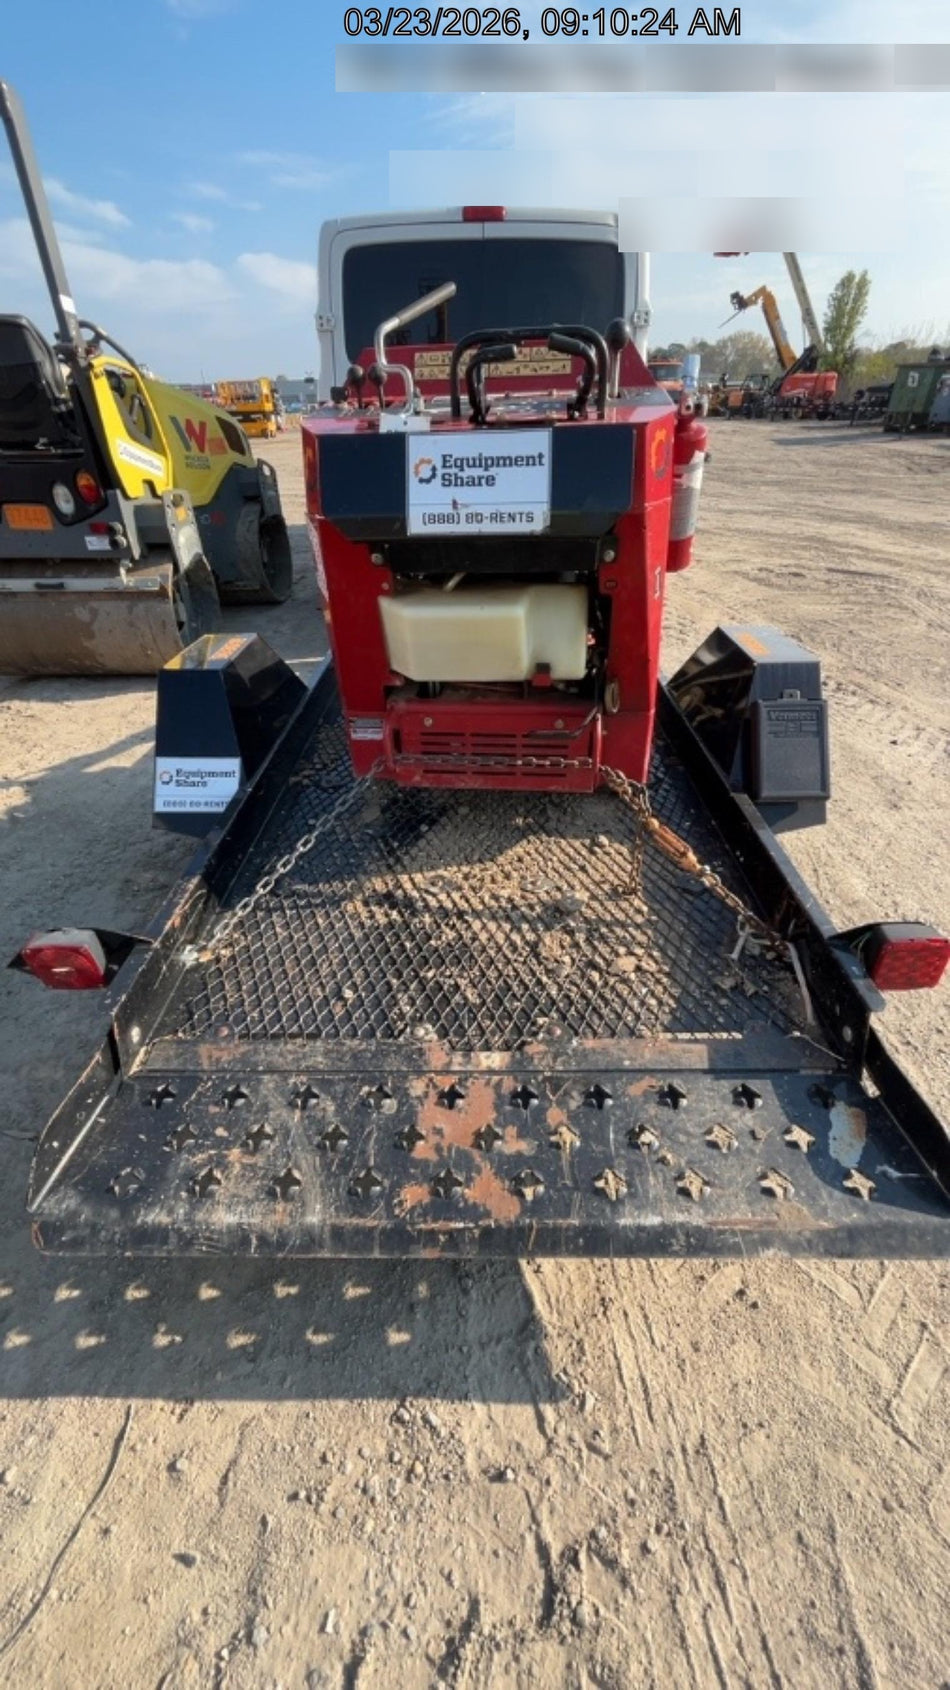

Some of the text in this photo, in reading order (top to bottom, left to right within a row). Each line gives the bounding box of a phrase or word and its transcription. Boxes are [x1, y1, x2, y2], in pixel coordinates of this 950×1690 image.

[441, 452, 545, 471] Equipment
[441, 472, 496, 487] Share
[422, 511, 535, 526] (888) 80-RENTS
